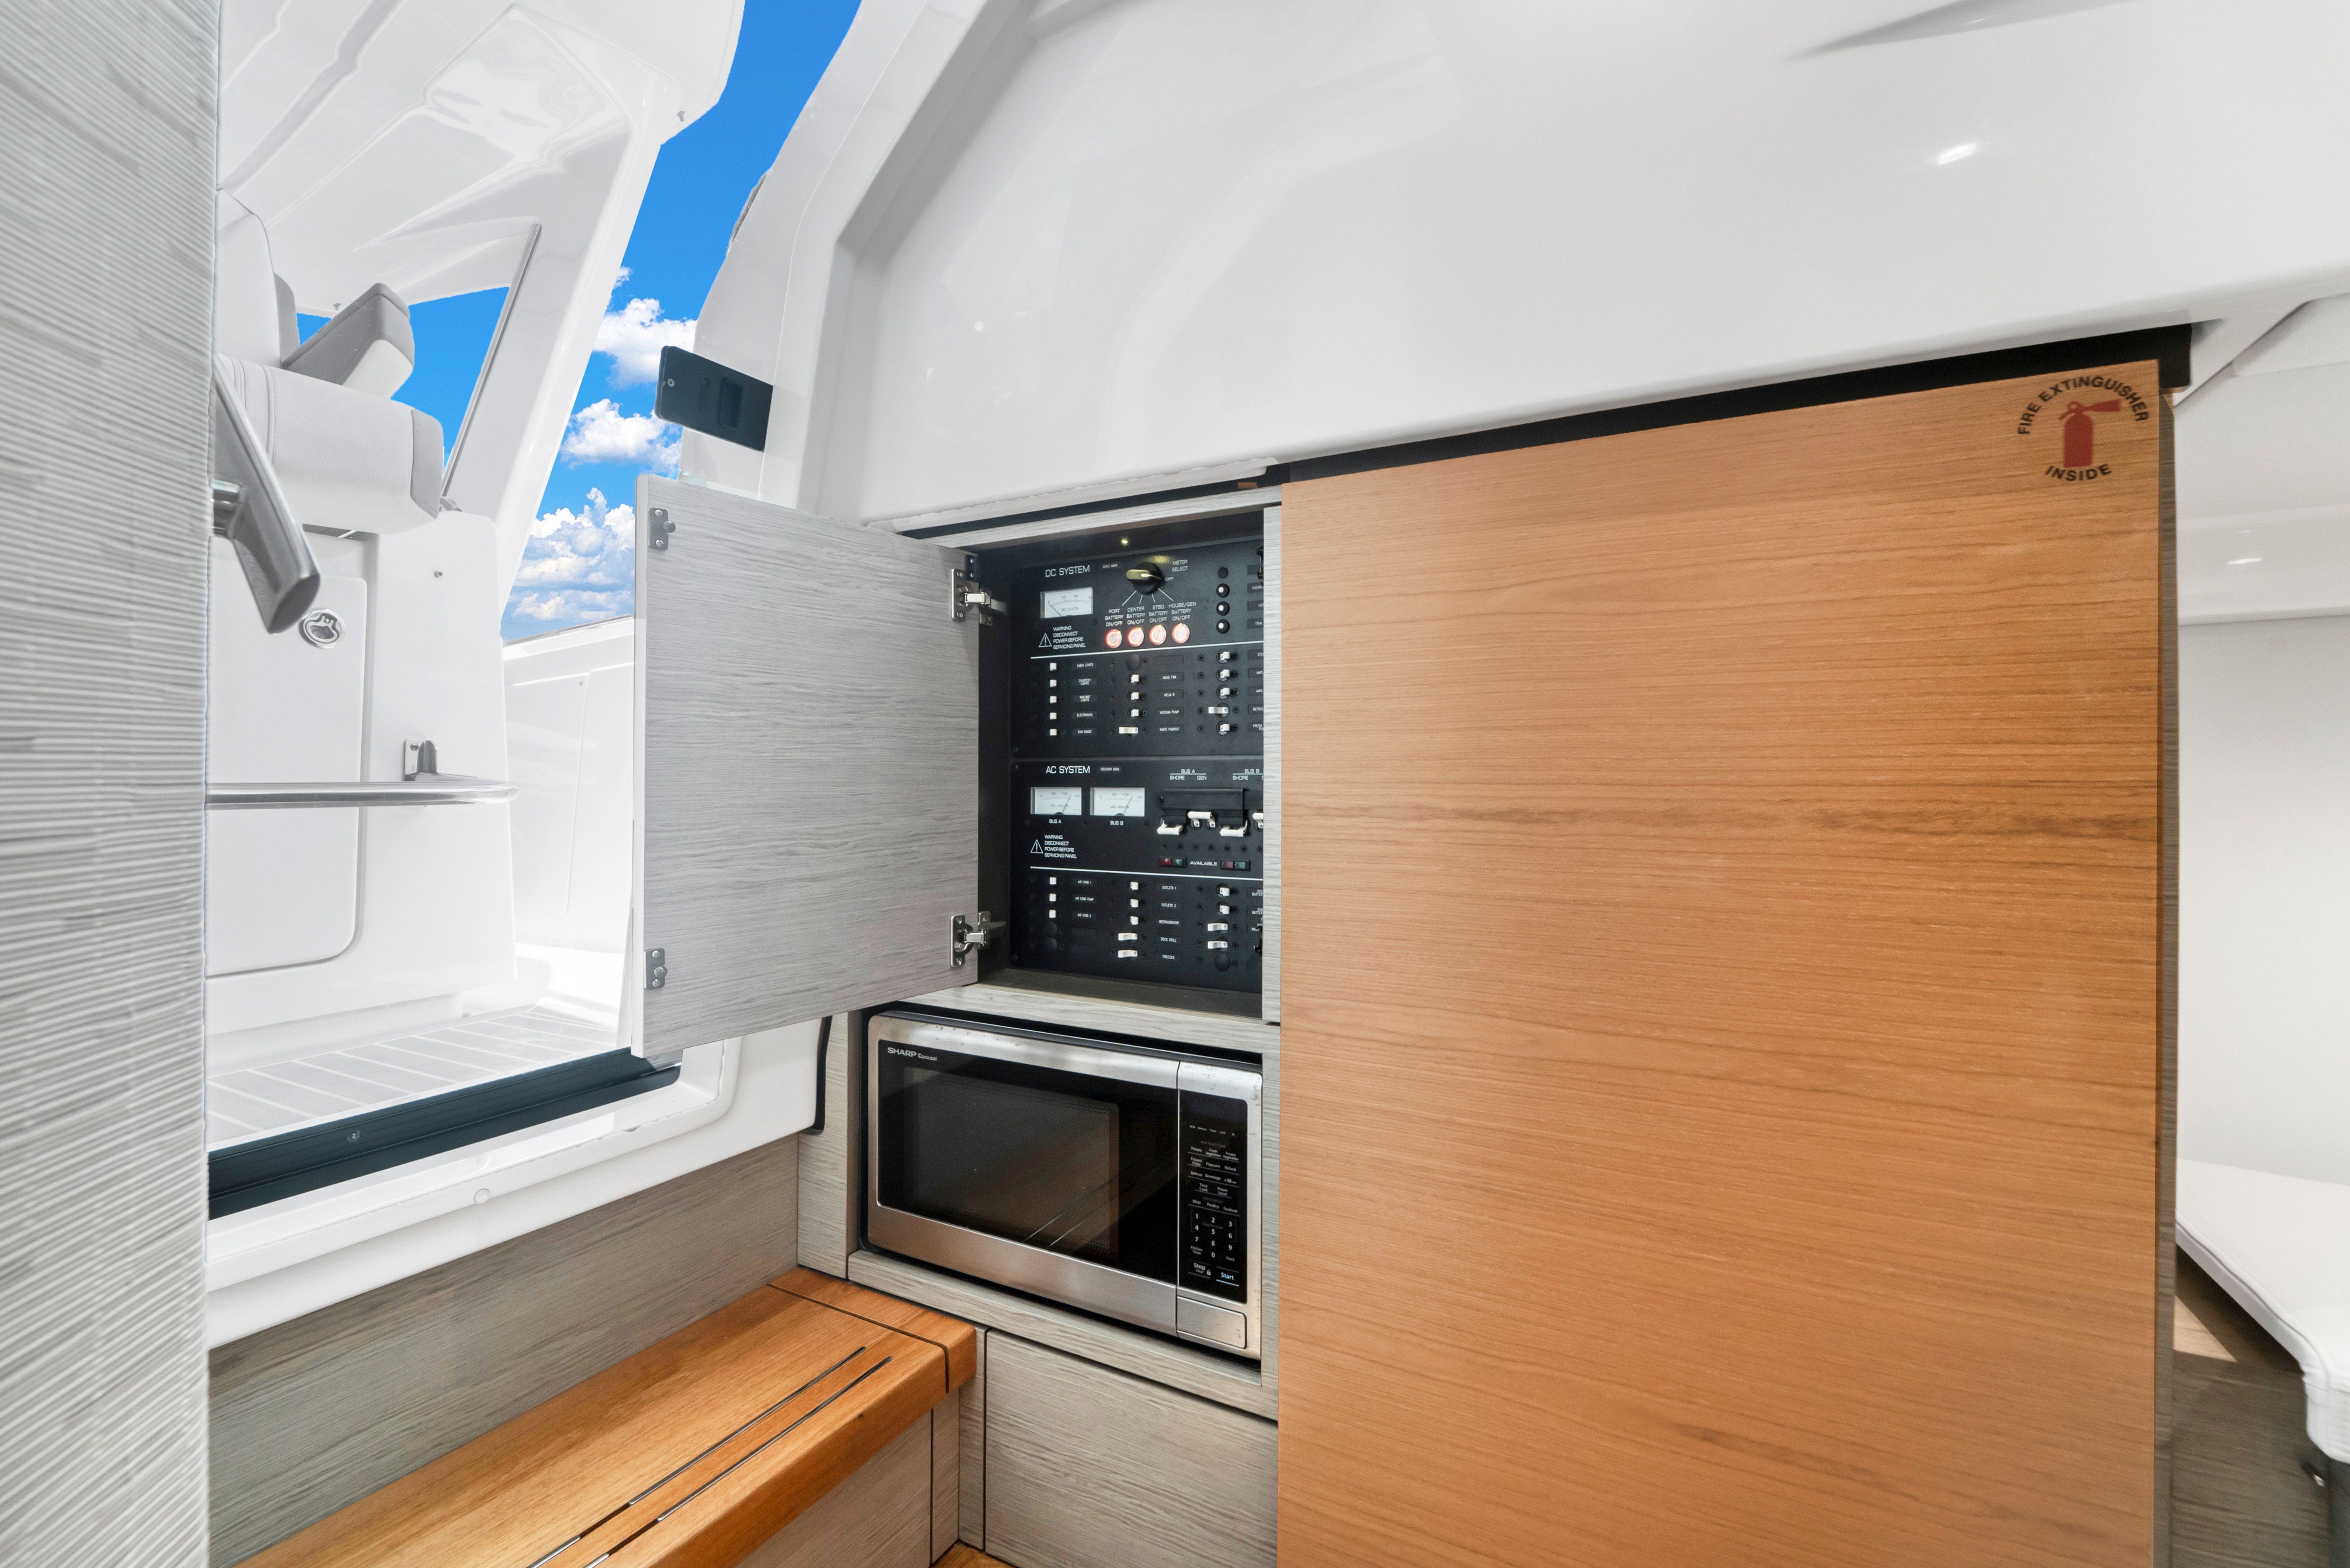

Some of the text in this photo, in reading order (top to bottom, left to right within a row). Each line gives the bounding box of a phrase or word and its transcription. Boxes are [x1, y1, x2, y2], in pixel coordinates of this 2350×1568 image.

[2018, 376, 2149, 435] FIRE EXTINGUISHER
[2045, 463, 2111, 481] INSIDE
[1059, 565, 1090, 575] SYSTEM
[888, 1047, 917, 1057] SHARP
